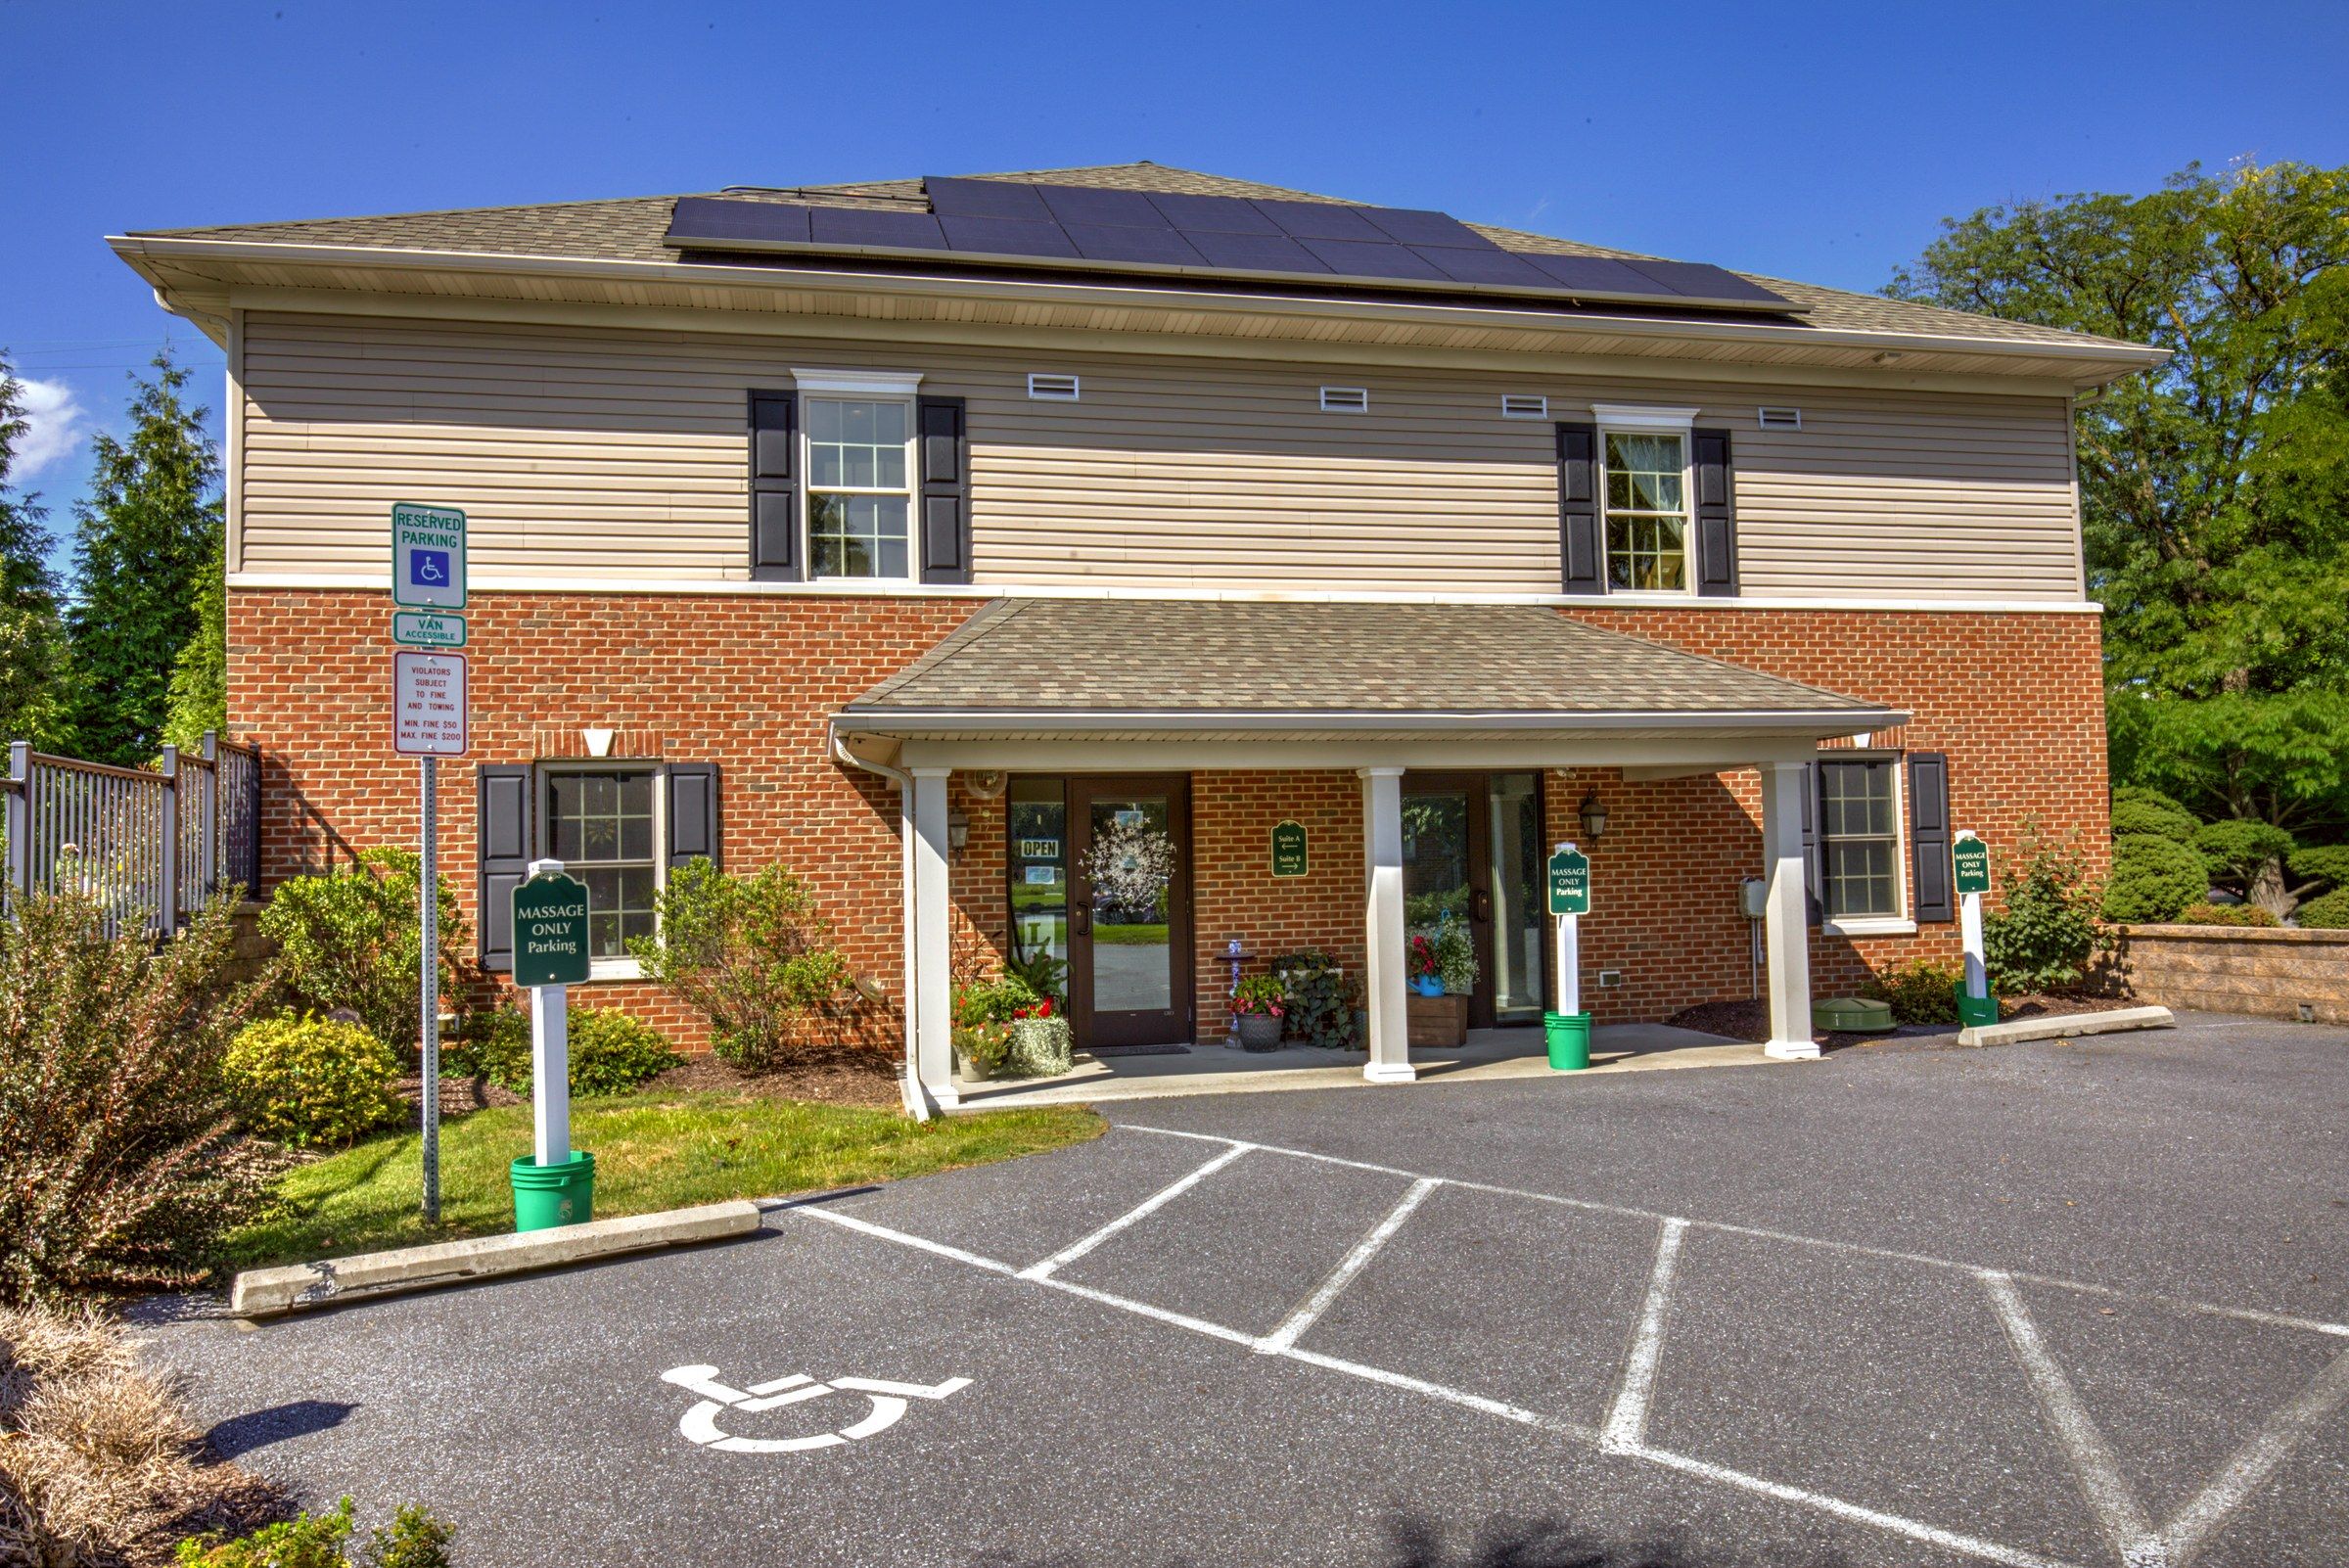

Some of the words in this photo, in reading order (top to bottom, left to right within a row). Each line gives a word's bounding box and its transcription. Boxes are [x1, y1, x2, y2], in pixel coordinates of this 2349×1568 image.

[397, 513, 461, 530] RESERVED
[402, 530, 457, 548] PARKING
[418, 620, 443, 630] VAN
[405, 630, 456, 640] ACCESSIBLE
[411, 667, 451, 676] VIOLATORS
[415, 679, 447, 688] SUBJECT
[429, 703, 455, 712] TOWING
[442, 720, 457, 729] $50
[441, 732, 461, 741] $200
[1024, 842, 1056, 856] OPEN
[1960, 869, 1984, 878] Parking
[1556, 887, 1583, 898] Parking
[518, 904, 584, 919] MASSAGE
[531, 922, 572, 936] ONLY
[529, 940, 576, 954] Parking
